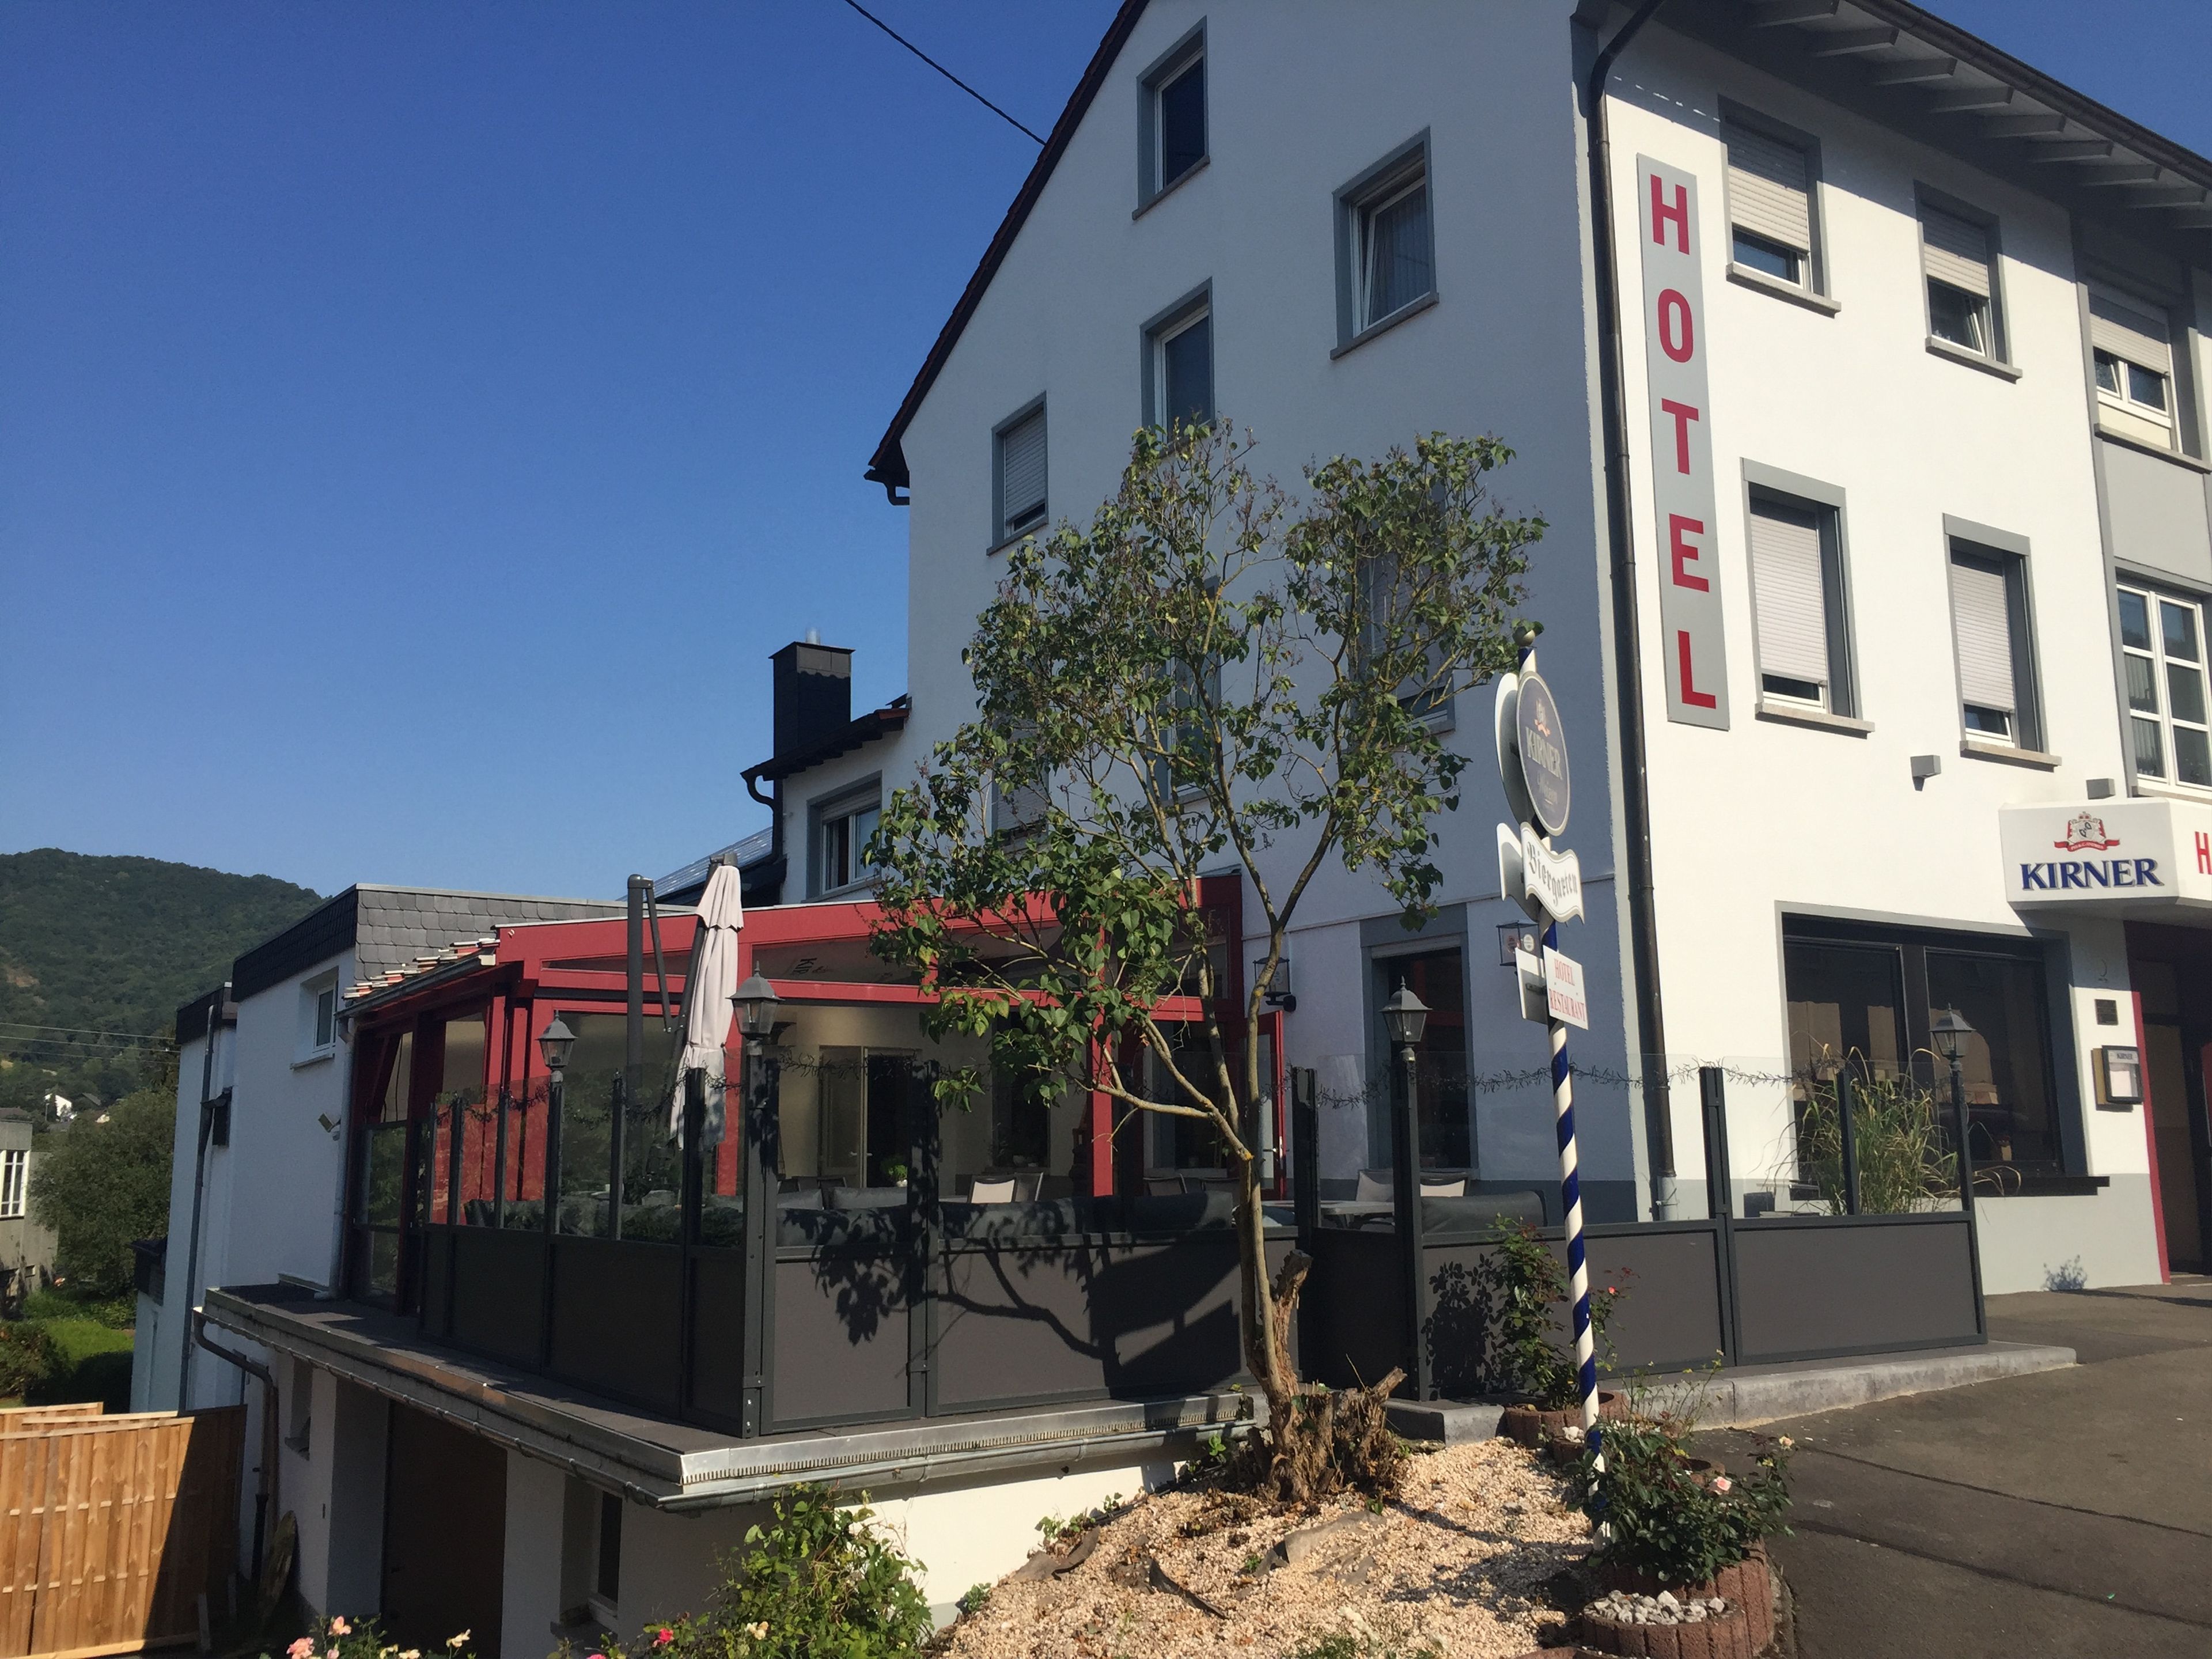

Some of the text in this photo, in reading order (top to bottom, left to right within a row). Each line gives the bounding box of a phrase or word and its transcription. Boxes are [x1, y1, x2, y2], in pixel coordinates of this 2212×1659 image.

[1650, 174, 1716, 709] HOTEL
[1525, 726, 1563, 780] KIRNER
[1527, 841, 1578, 907] Biergarten
[2020, 858, 2165, 891] KIRNER
[1554, 957, 1575, 987] HOTEL
[1549, 988, 1586, 1022] RESTAURANT
